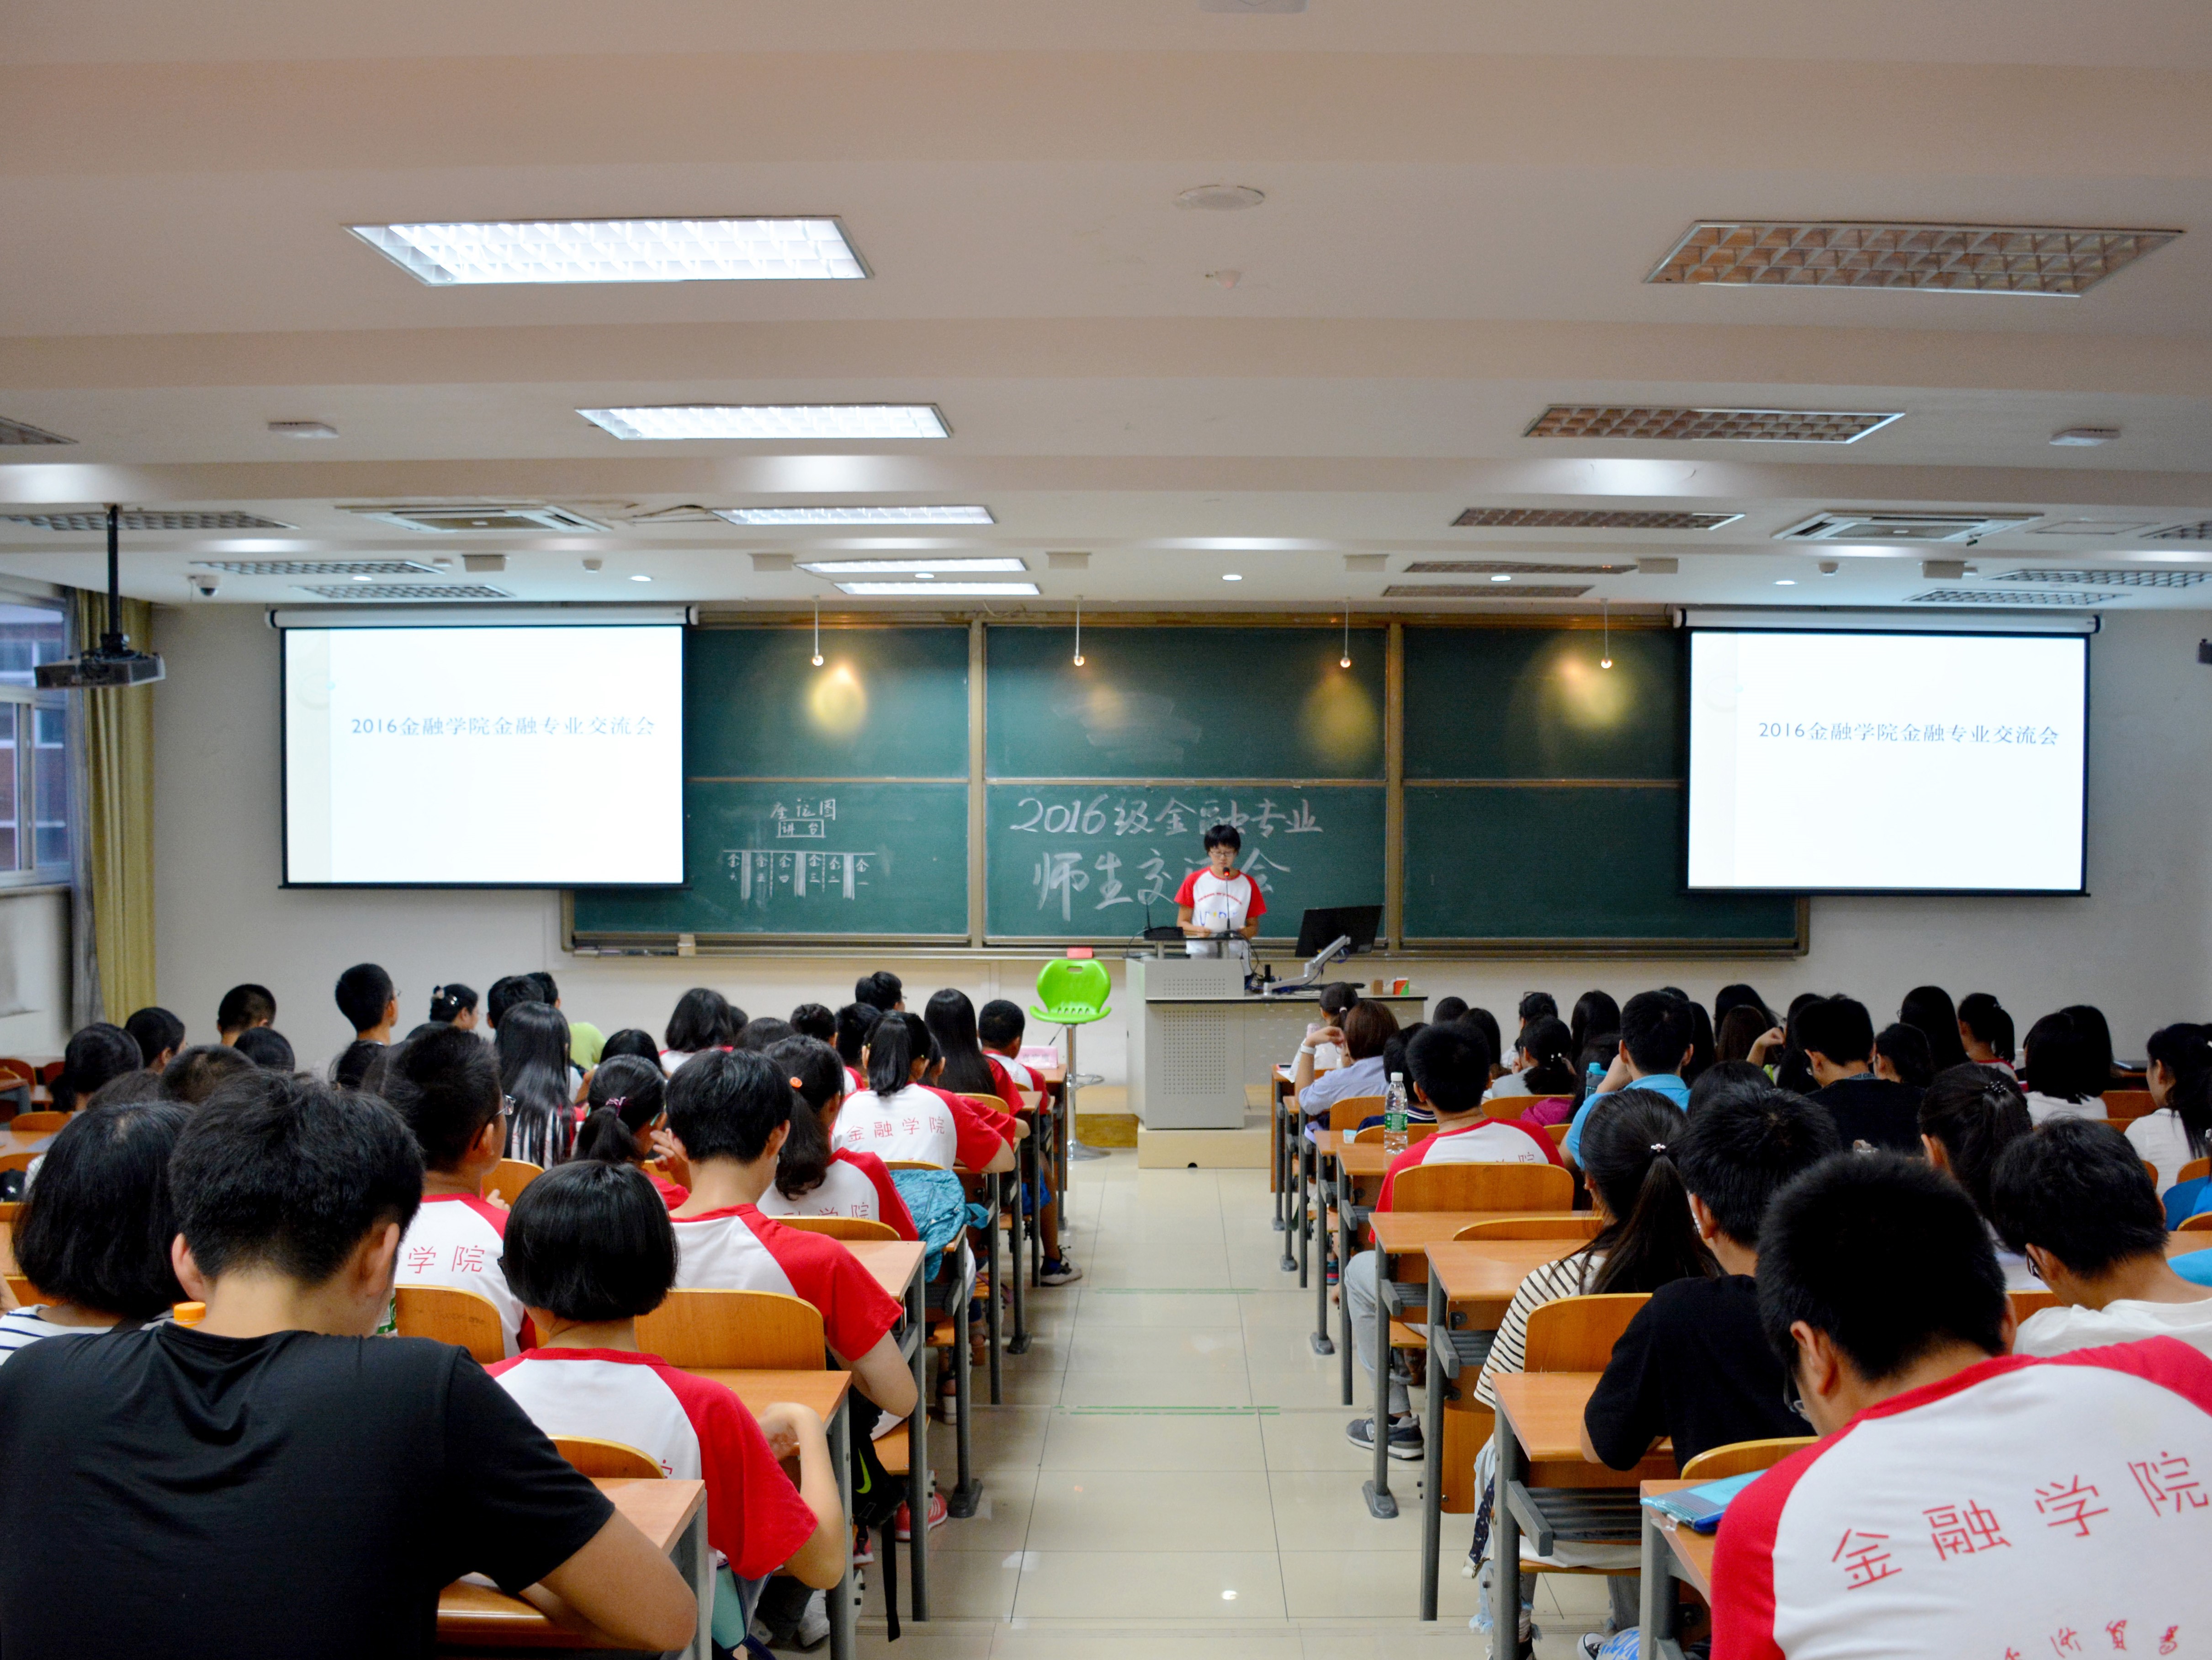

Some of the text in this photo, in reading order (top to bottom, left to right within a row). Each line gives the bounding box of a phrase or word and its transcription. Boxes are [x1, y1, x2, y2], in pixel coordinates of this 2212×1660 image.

[351, 716, 655, 736] 2016金融学院金融专业交流会
[1759, 722, 2059, 745] 2016金融学院金融专业交流会
[1033, 847, 1291, 922] 师生交会
[847, 1116, 945, 1142] 金融学院
[407, 1245, 485, 1274] 学院
[1831, 1451, 2208, 1591] 金融学院
